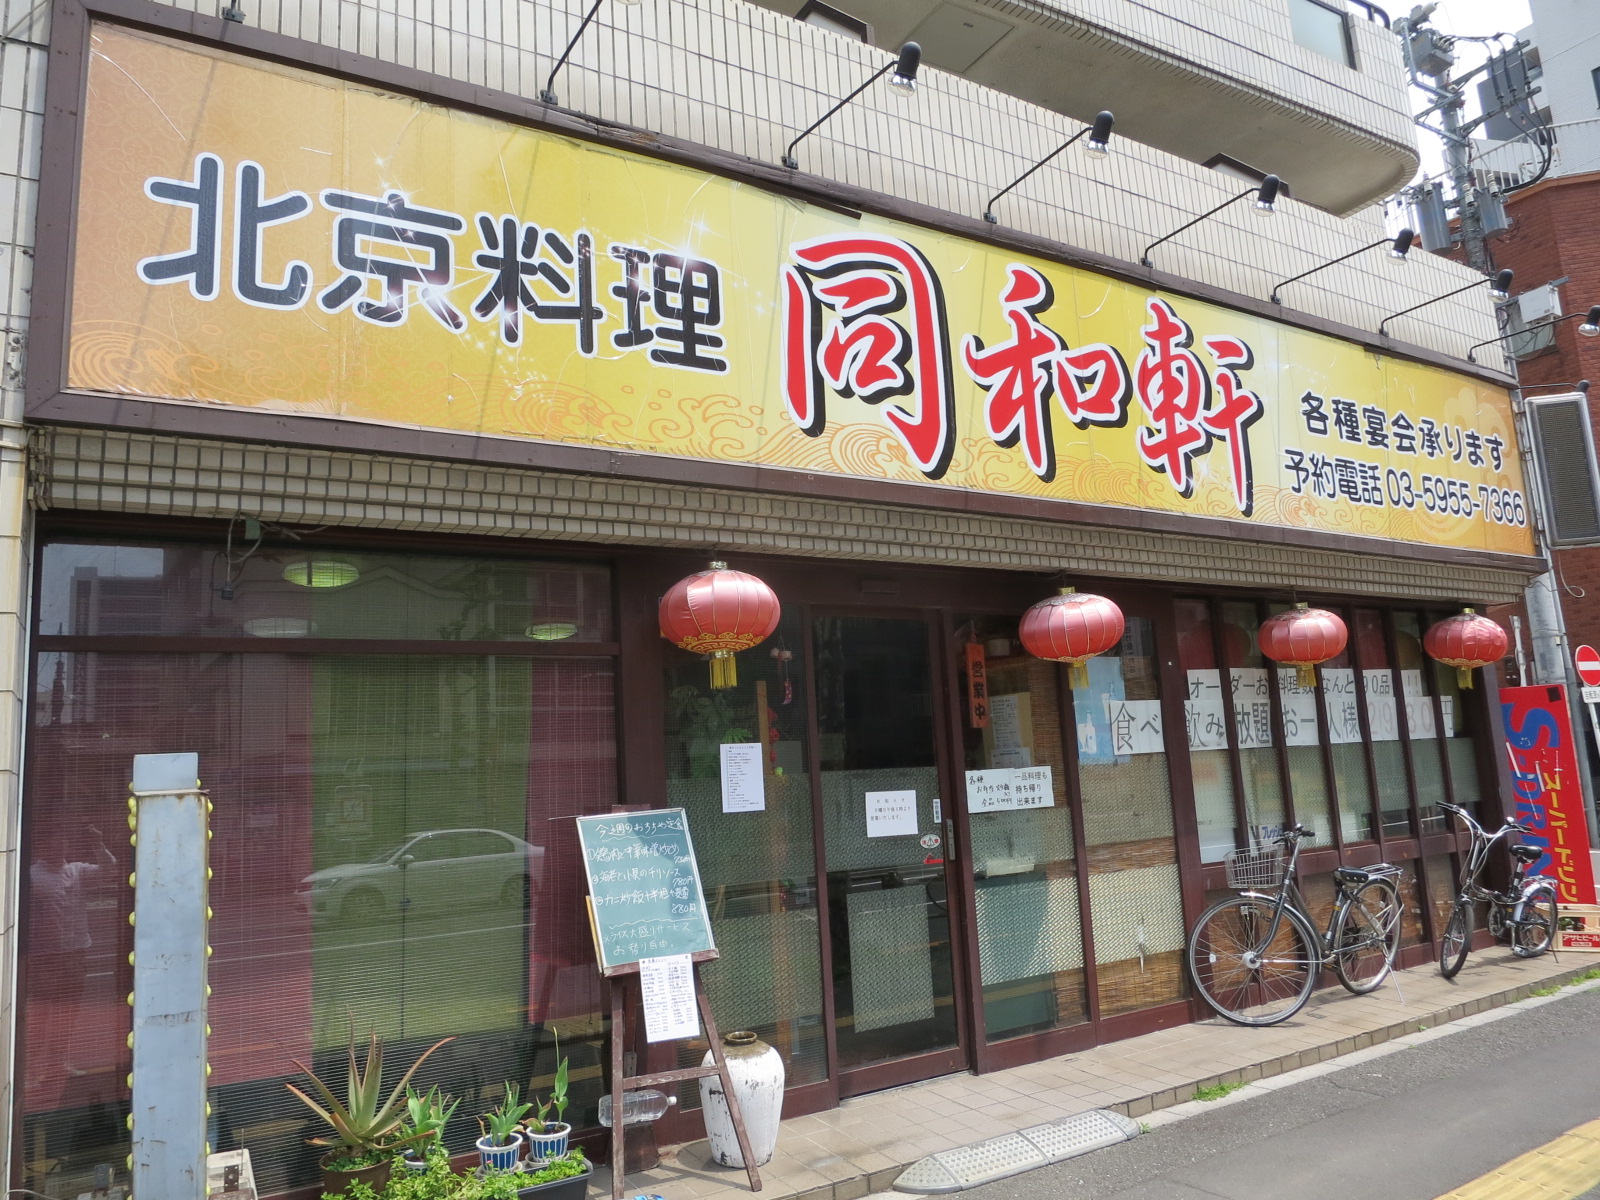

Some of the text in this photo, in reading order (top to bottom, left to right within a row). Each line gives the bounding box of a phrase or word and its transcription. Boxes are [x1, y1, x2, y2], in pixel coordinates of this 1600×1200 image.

[138, 153, 728, 375] 北京料理
[780, 233, 1264, 517] 同和軒
[1300, 390, 1505, 471] 各種宴会承ります
[1284, 448, 1526, 527] 予約電話 03-5955-7366
[971, 660, 986, 720] 営業中
[1014, 771, 1048, 781] 一品料理も
[1015, 783, 1042, 794] 持ち帰り
[1016, 796, 1043, 807] 出来ます
[1500, 702, 1560, 903] S-DRIN
[1562, 934, 1600, 942] アサヒビール
